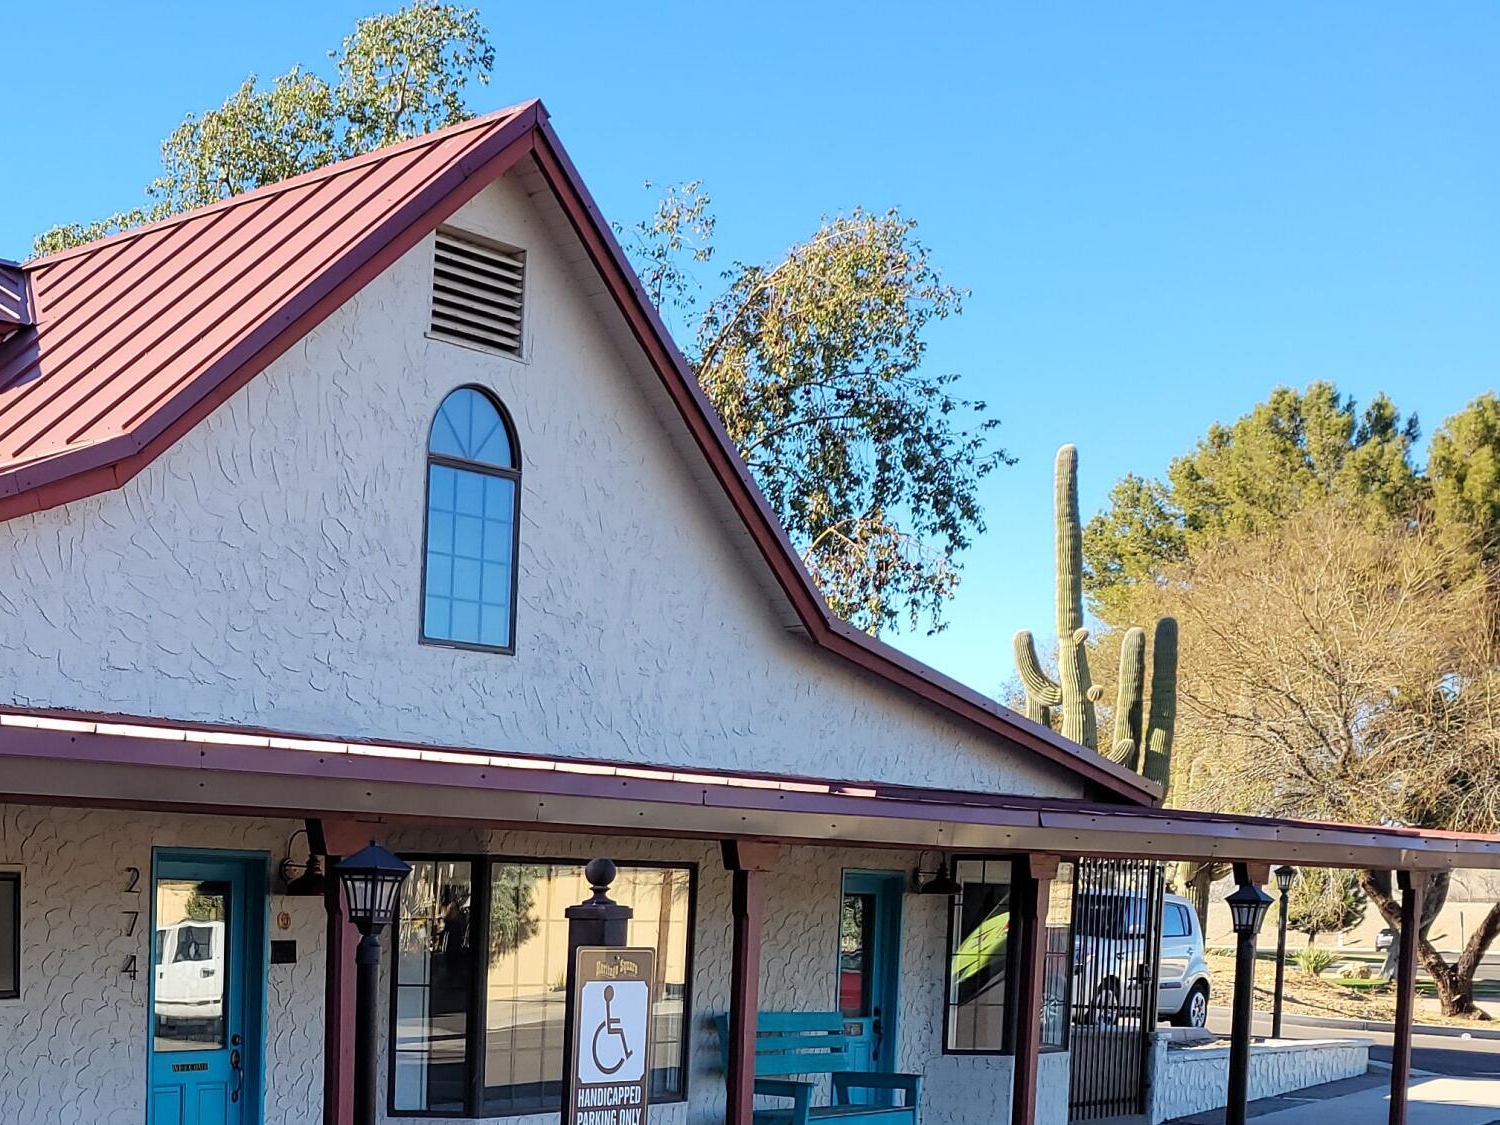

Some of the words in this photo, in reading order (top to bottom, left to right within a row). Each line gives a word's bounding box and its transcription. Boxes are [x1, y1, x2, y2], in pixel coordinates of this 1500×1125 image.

[121, 866, 141, 981] 274
[619, 959, 638, 977] Square
[577, 1085, 642, 1108] HANDICAPPED
